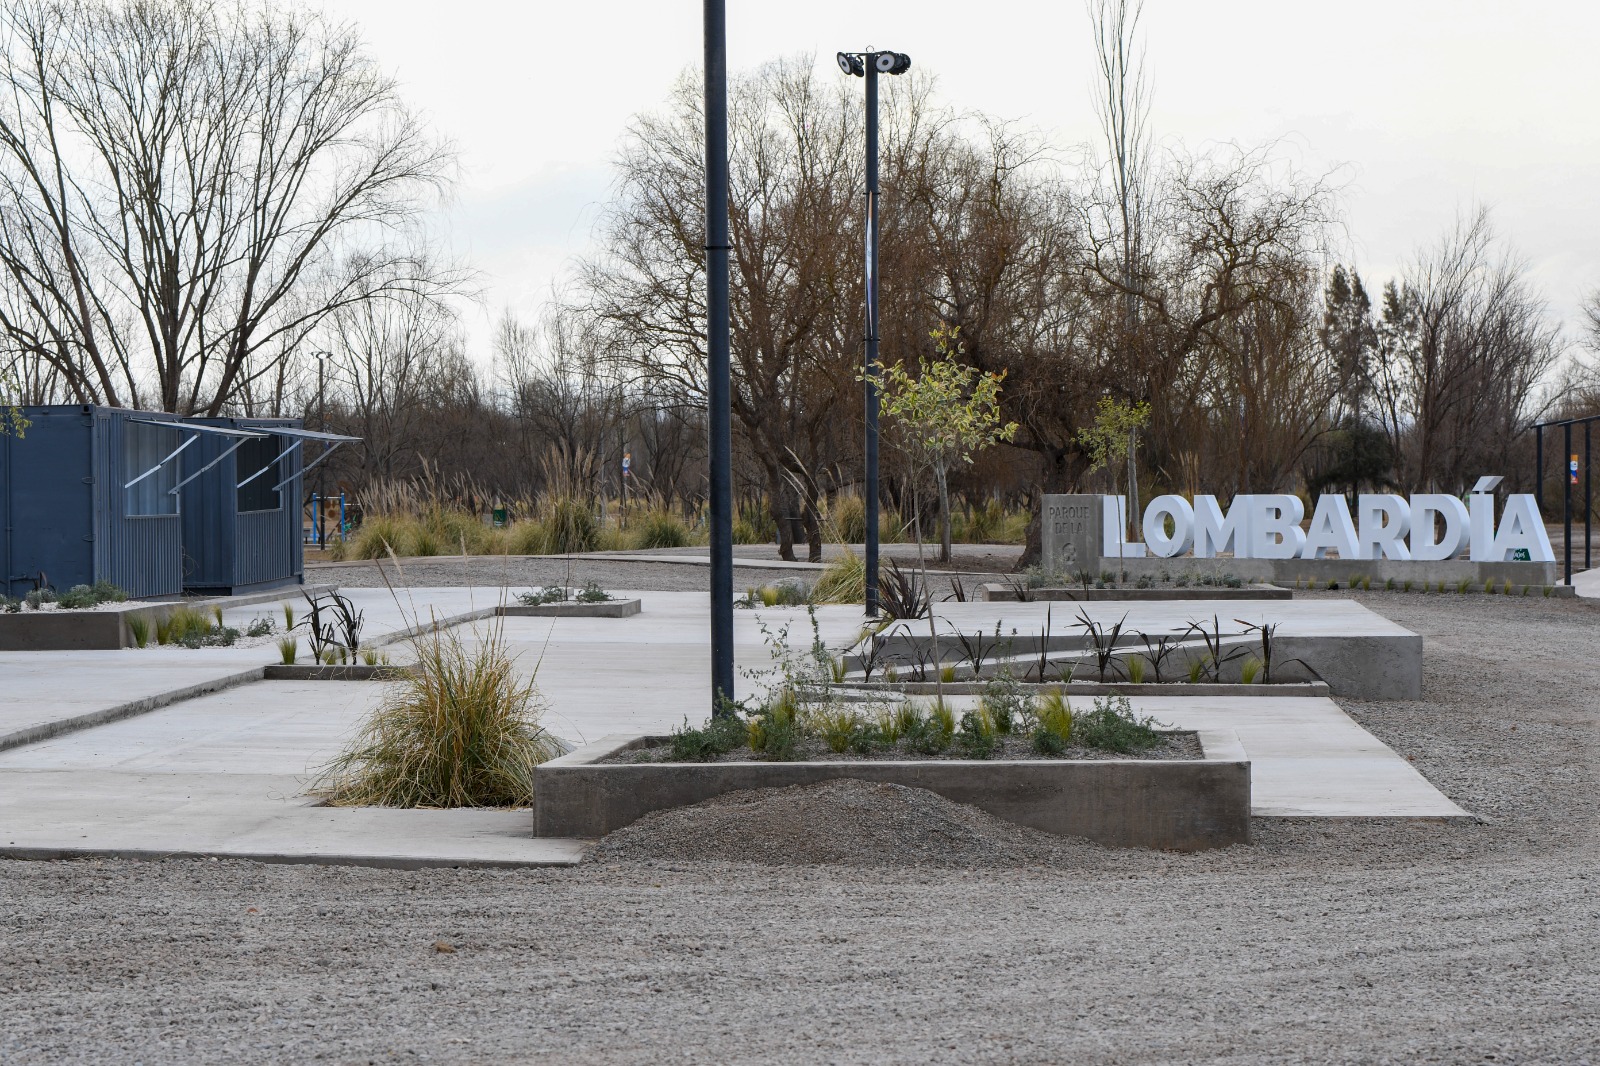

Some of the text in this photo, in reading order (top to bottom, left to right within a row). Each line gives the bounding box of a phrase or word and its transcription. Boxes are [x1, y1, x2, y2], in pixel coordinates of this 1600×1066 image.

[1049, 507, 1090, 519] PARQUE
[1103, 476, 1556, 562] LOMBARDÍA
[1055, 522, 1083, 534] DE LA
